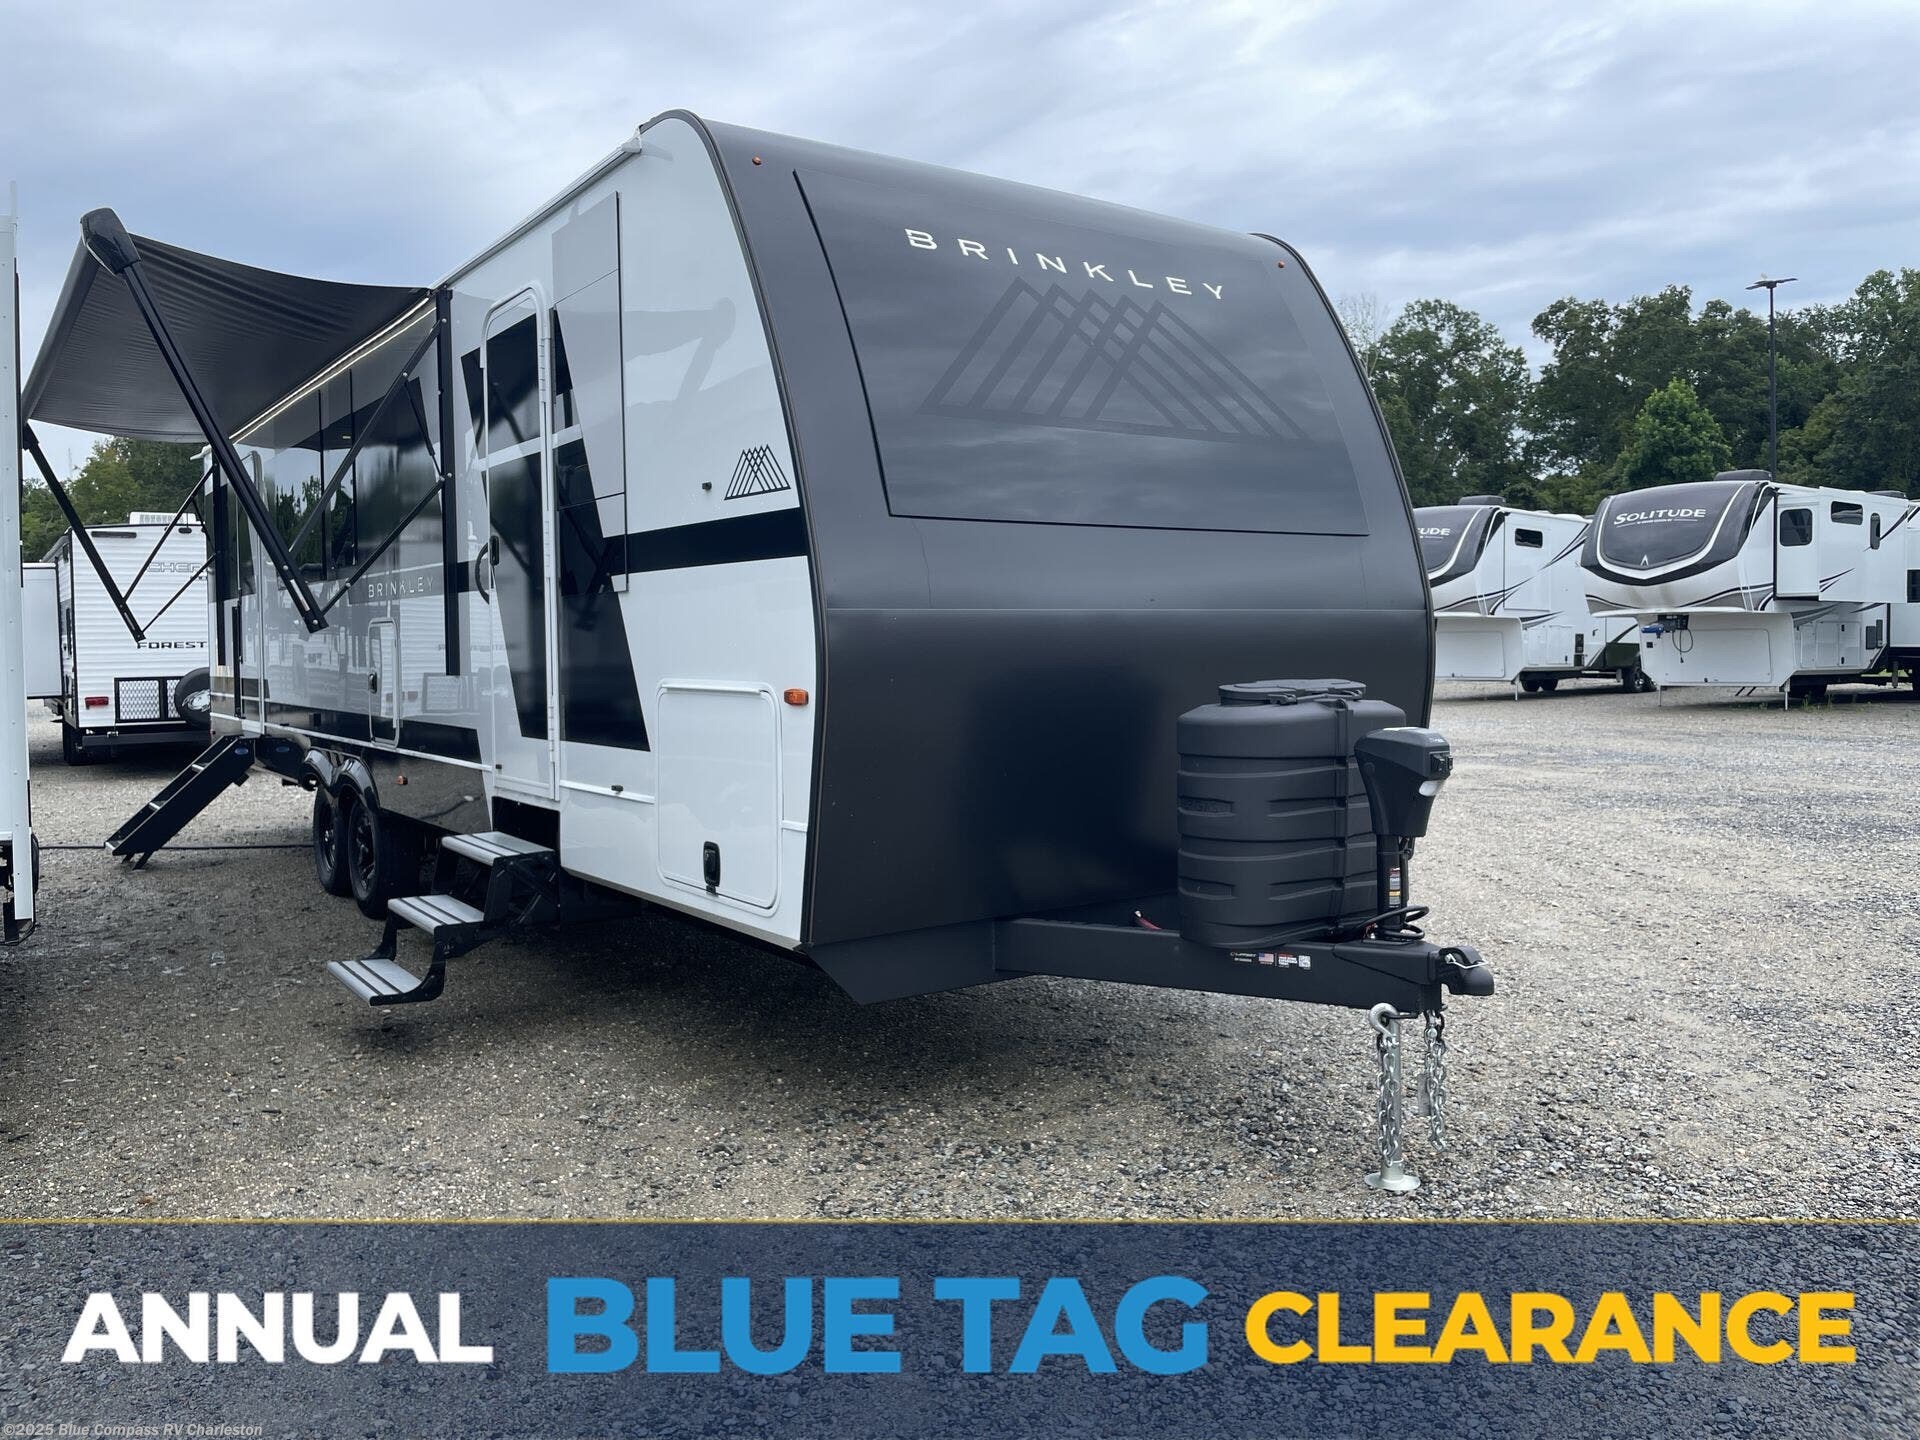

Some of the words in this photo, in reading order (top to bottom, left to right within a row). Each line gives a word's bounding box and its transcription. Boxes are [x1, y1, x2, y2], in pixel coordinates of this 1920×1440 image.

[904, 228, 1224, 300] BRINKLEY
[1613, 508, 1707, 525] SOLITUDE
[368, 576, 434, 598] BRINKLEY
[137, 641, 207, 650] FOREST
